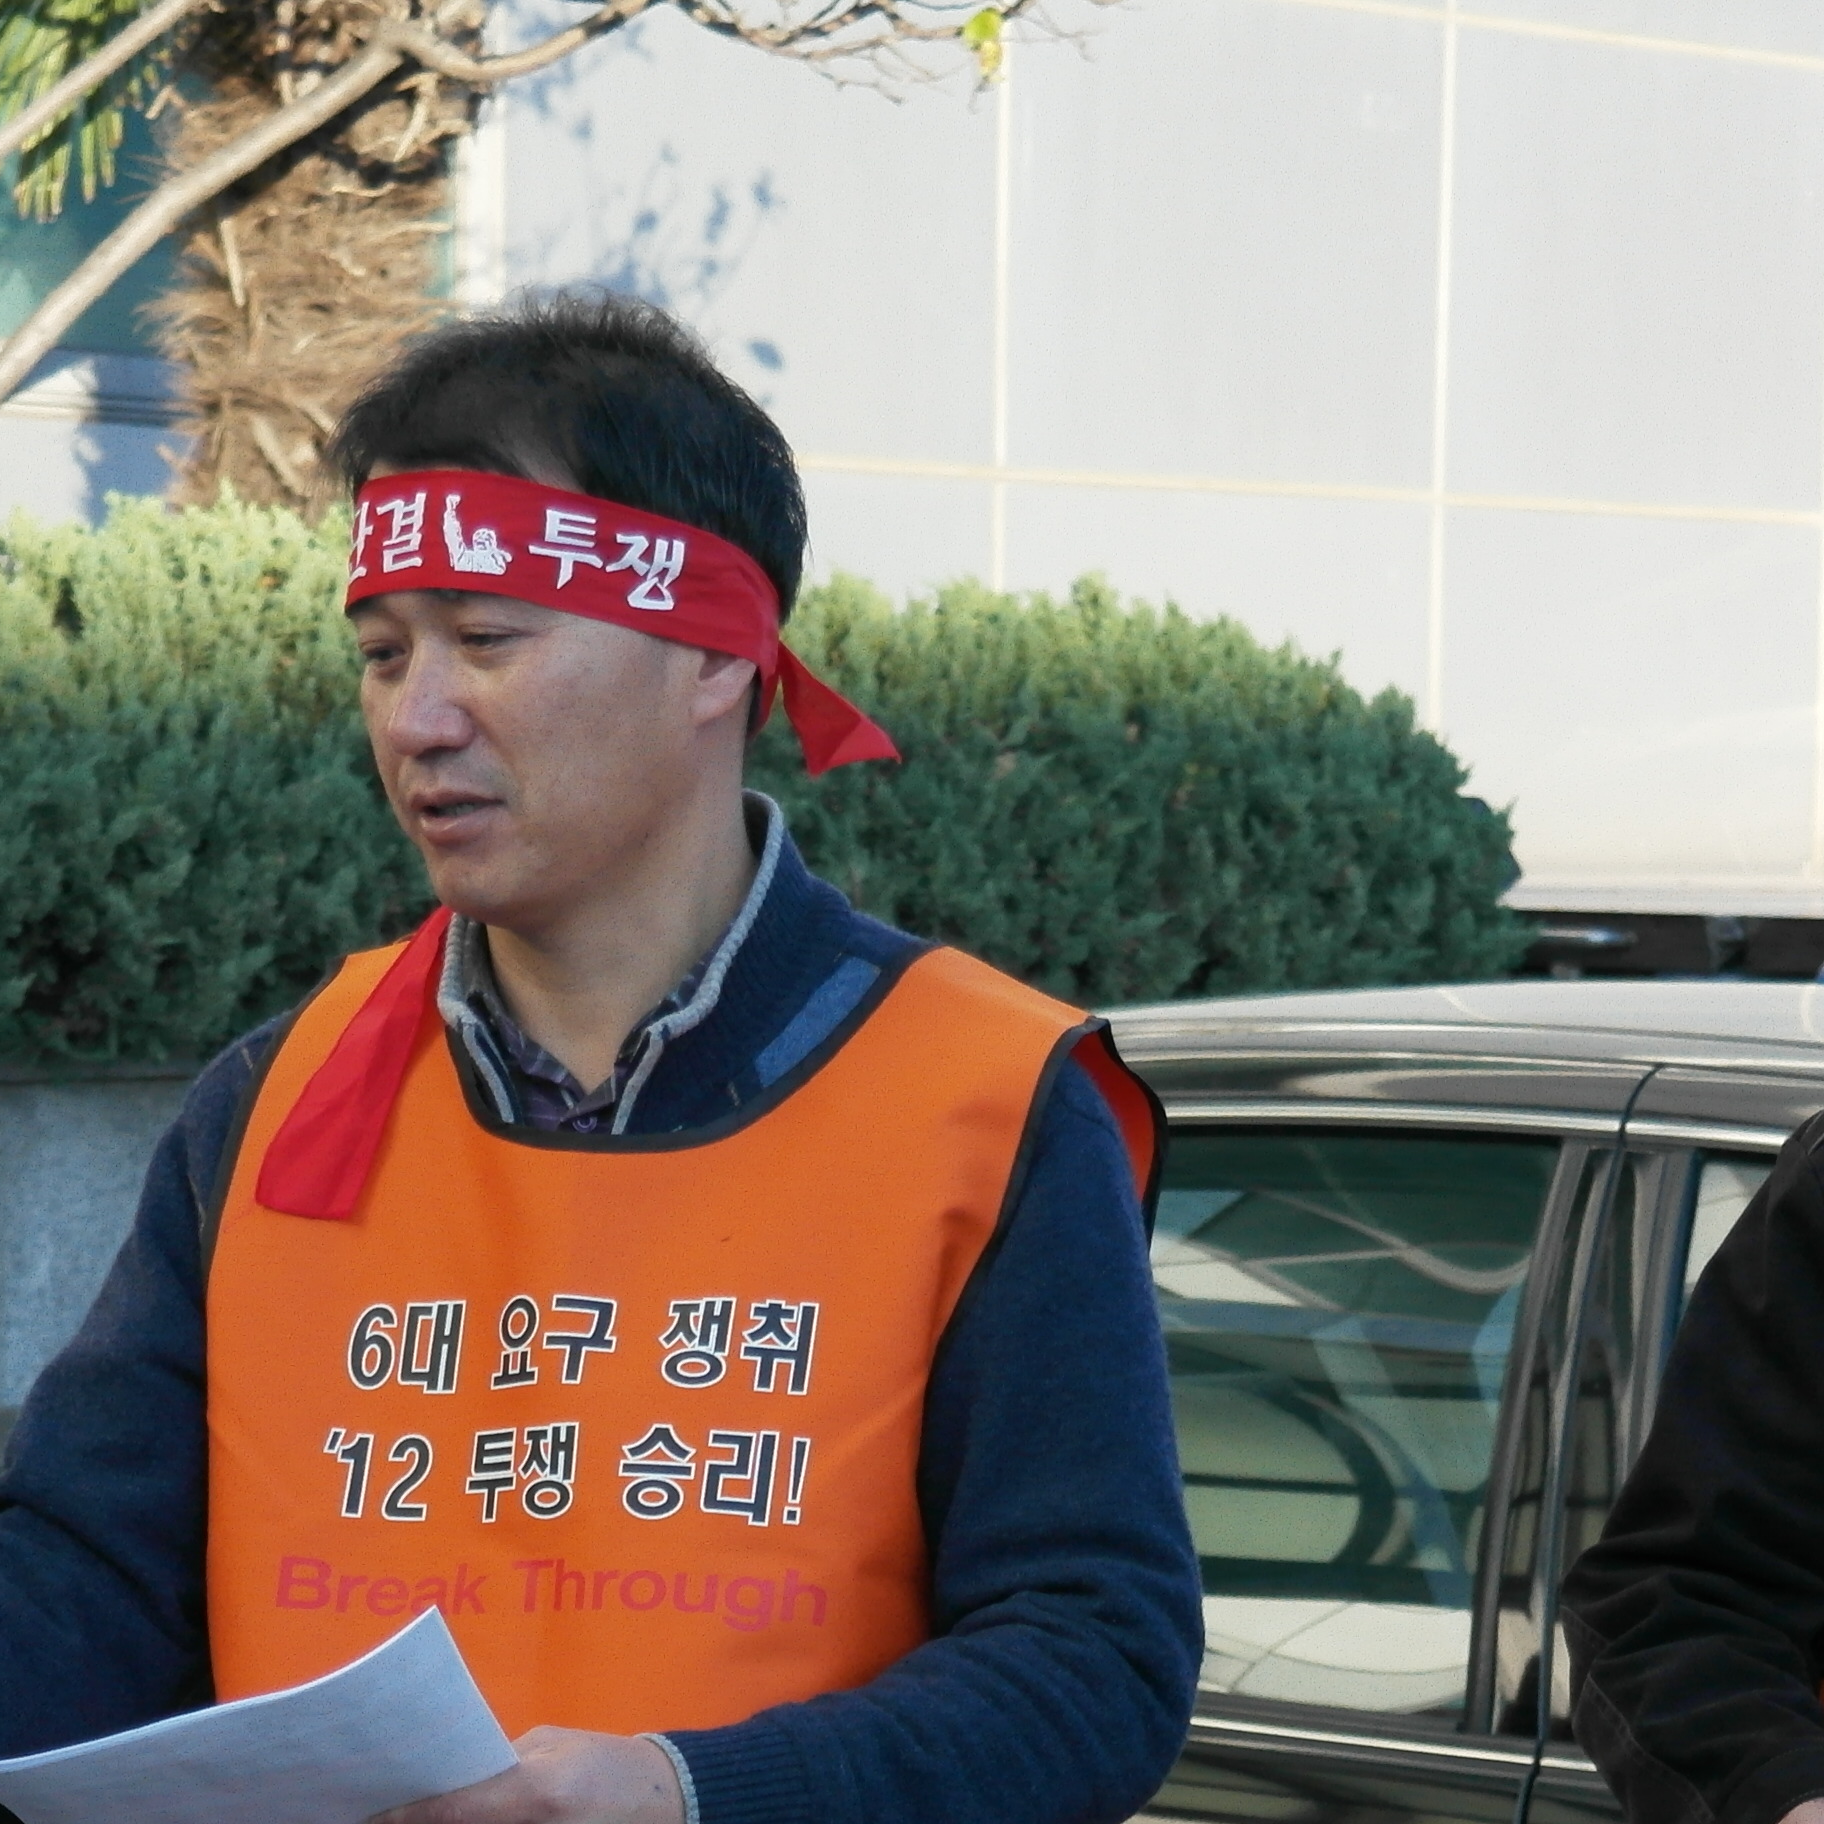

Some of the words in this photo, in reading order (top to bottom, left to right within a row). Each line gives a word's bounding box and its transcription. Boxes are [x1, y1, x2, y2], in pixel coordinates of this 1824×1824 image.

[528, 507, 687, 612] 투쟁
[347, 1300, 467, 1395] 6대
[490, 1294, 617, 1391] 요구
[657, 1297, 820, 1396] 쟁취
[323, 1426, 434, 1523] '12
[465, 1421, 579, 1524] 투쟁
[618, 1423, 812, 1527] 승리!
[276, 1555, 487, 1618] Break
[513, 1557, 828, 1633] Through
